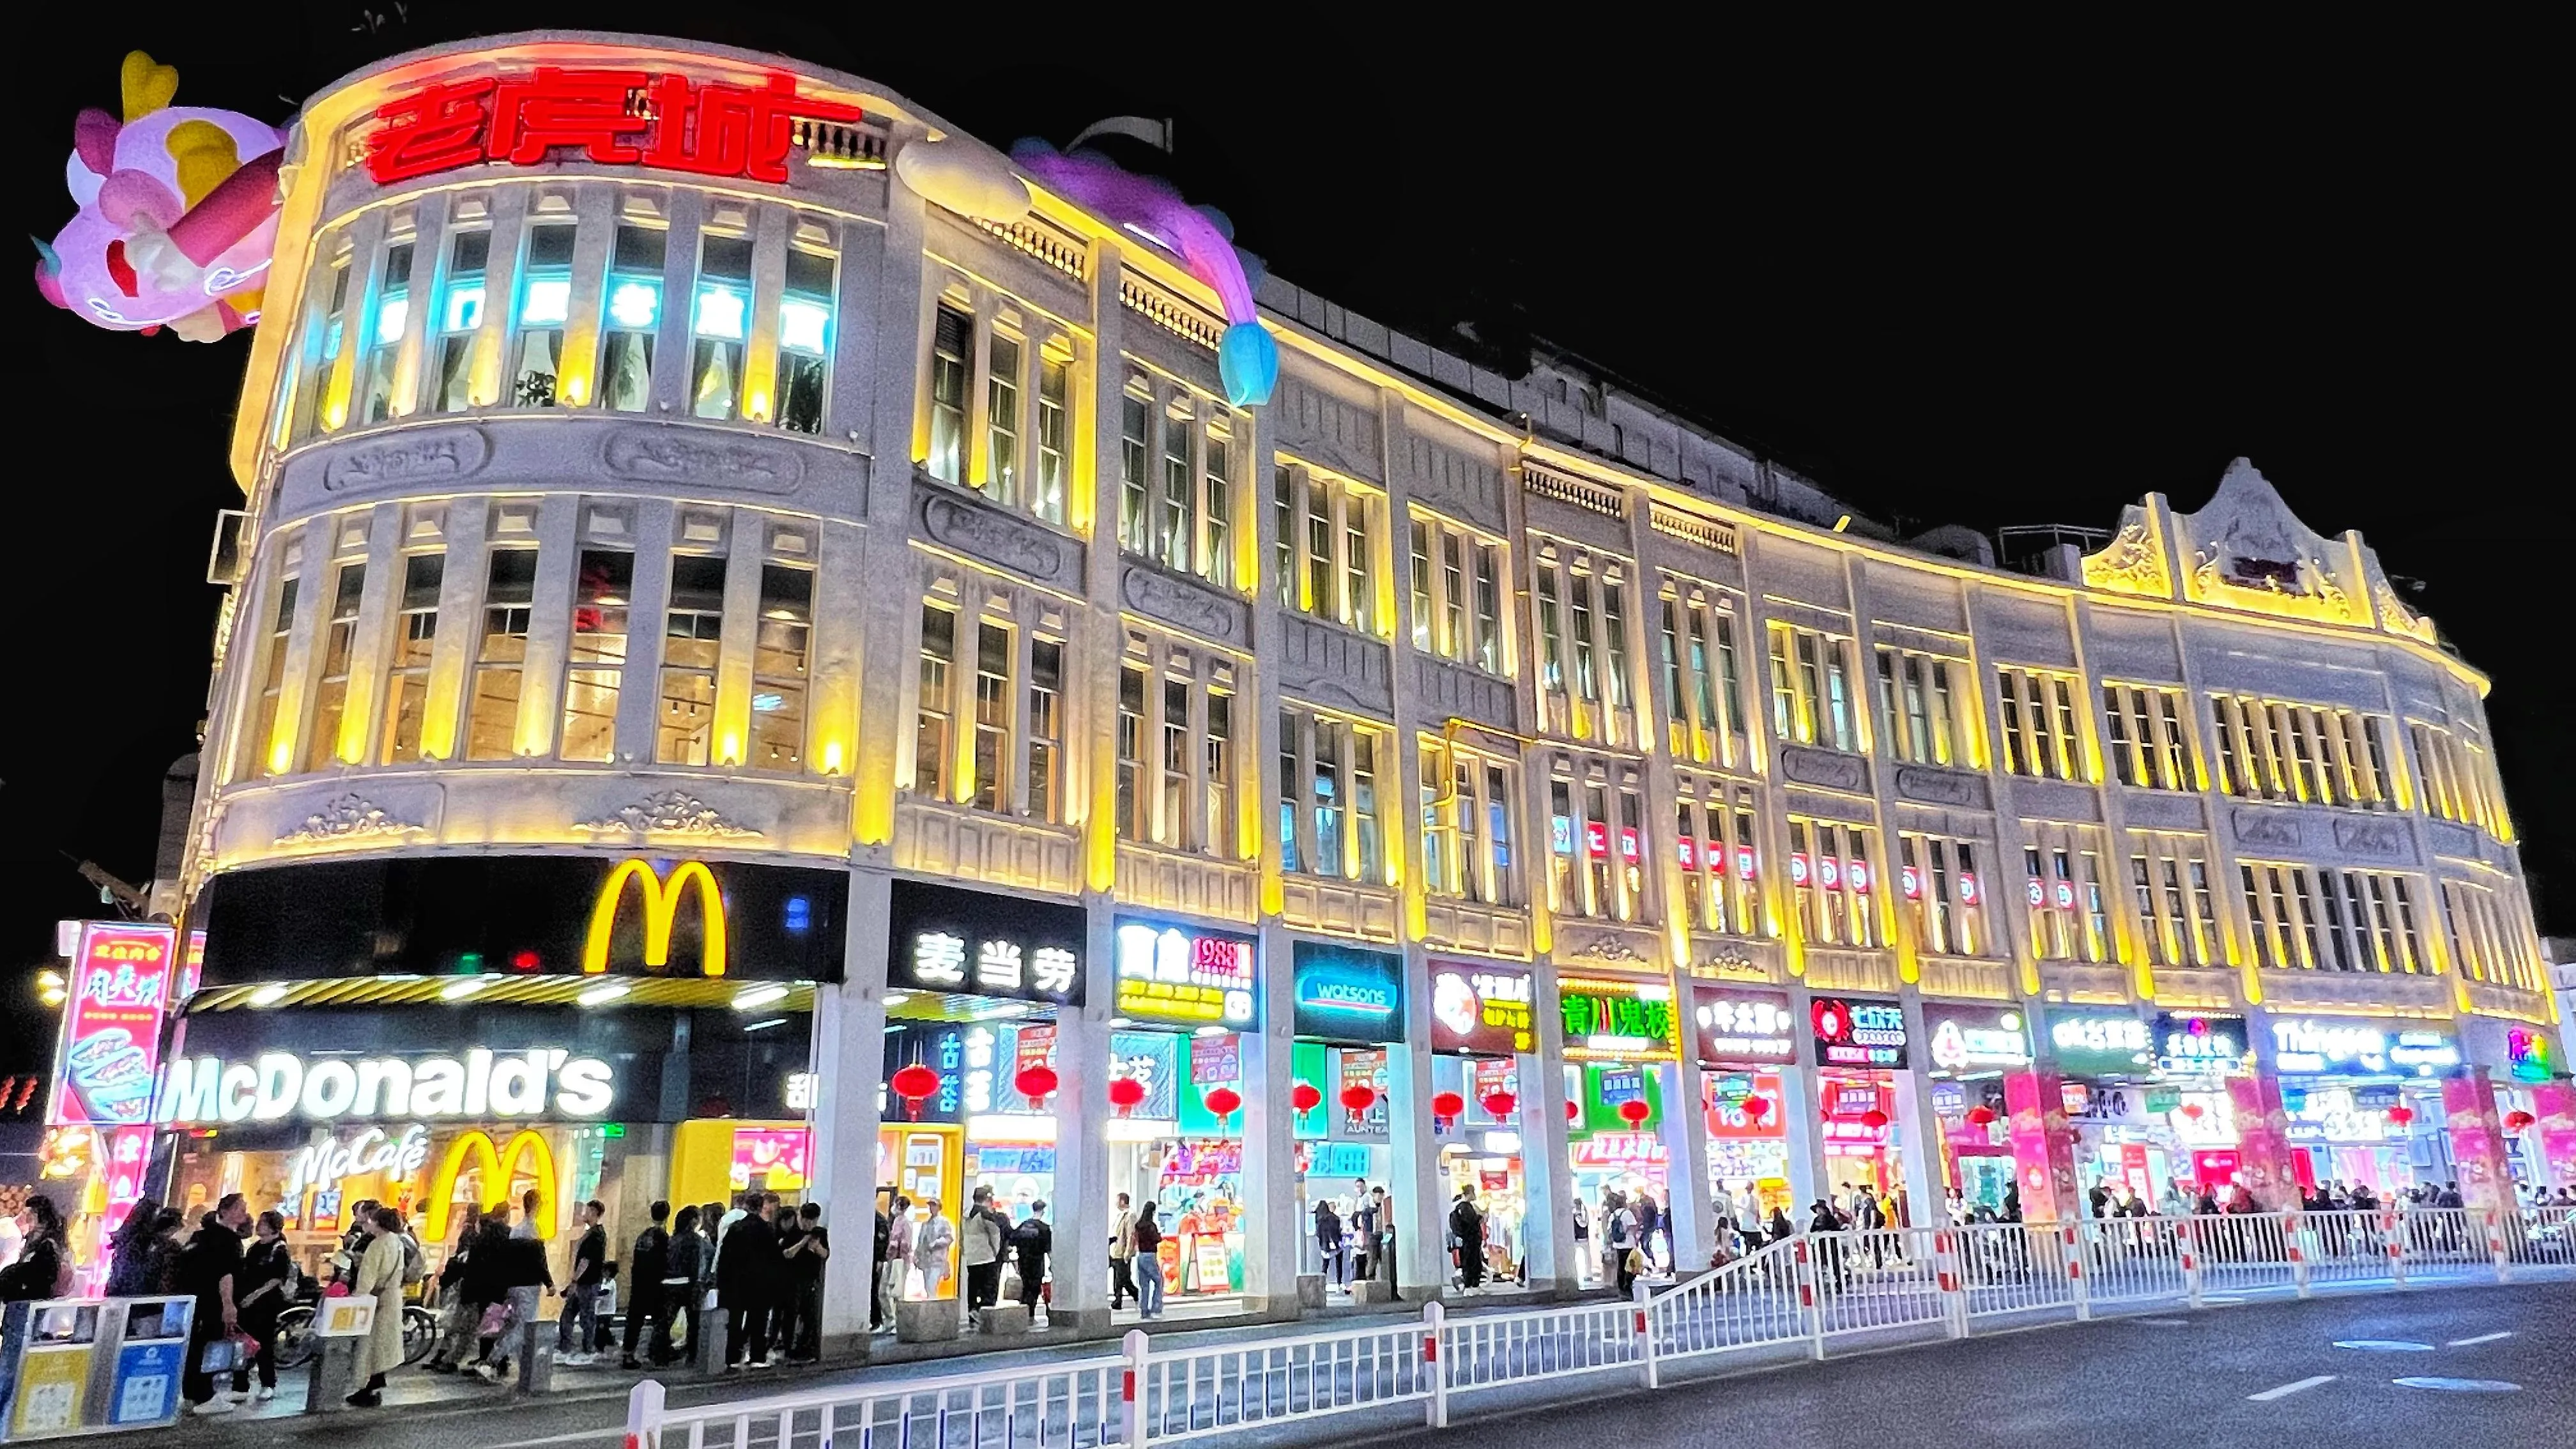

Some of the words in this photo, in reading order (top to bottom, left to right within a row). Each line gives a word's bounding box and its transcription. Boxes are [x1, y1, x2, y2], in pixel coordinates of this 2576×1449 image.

[366, 66, 862, 184] 老虎城
[914, 932, 1077, 992] 麦当劳
[1317, 982, 1386, 1004] watsons
[157, 1048, 614, 1123] McDonald's
[291, 1124, 429, 1196] McCafé
